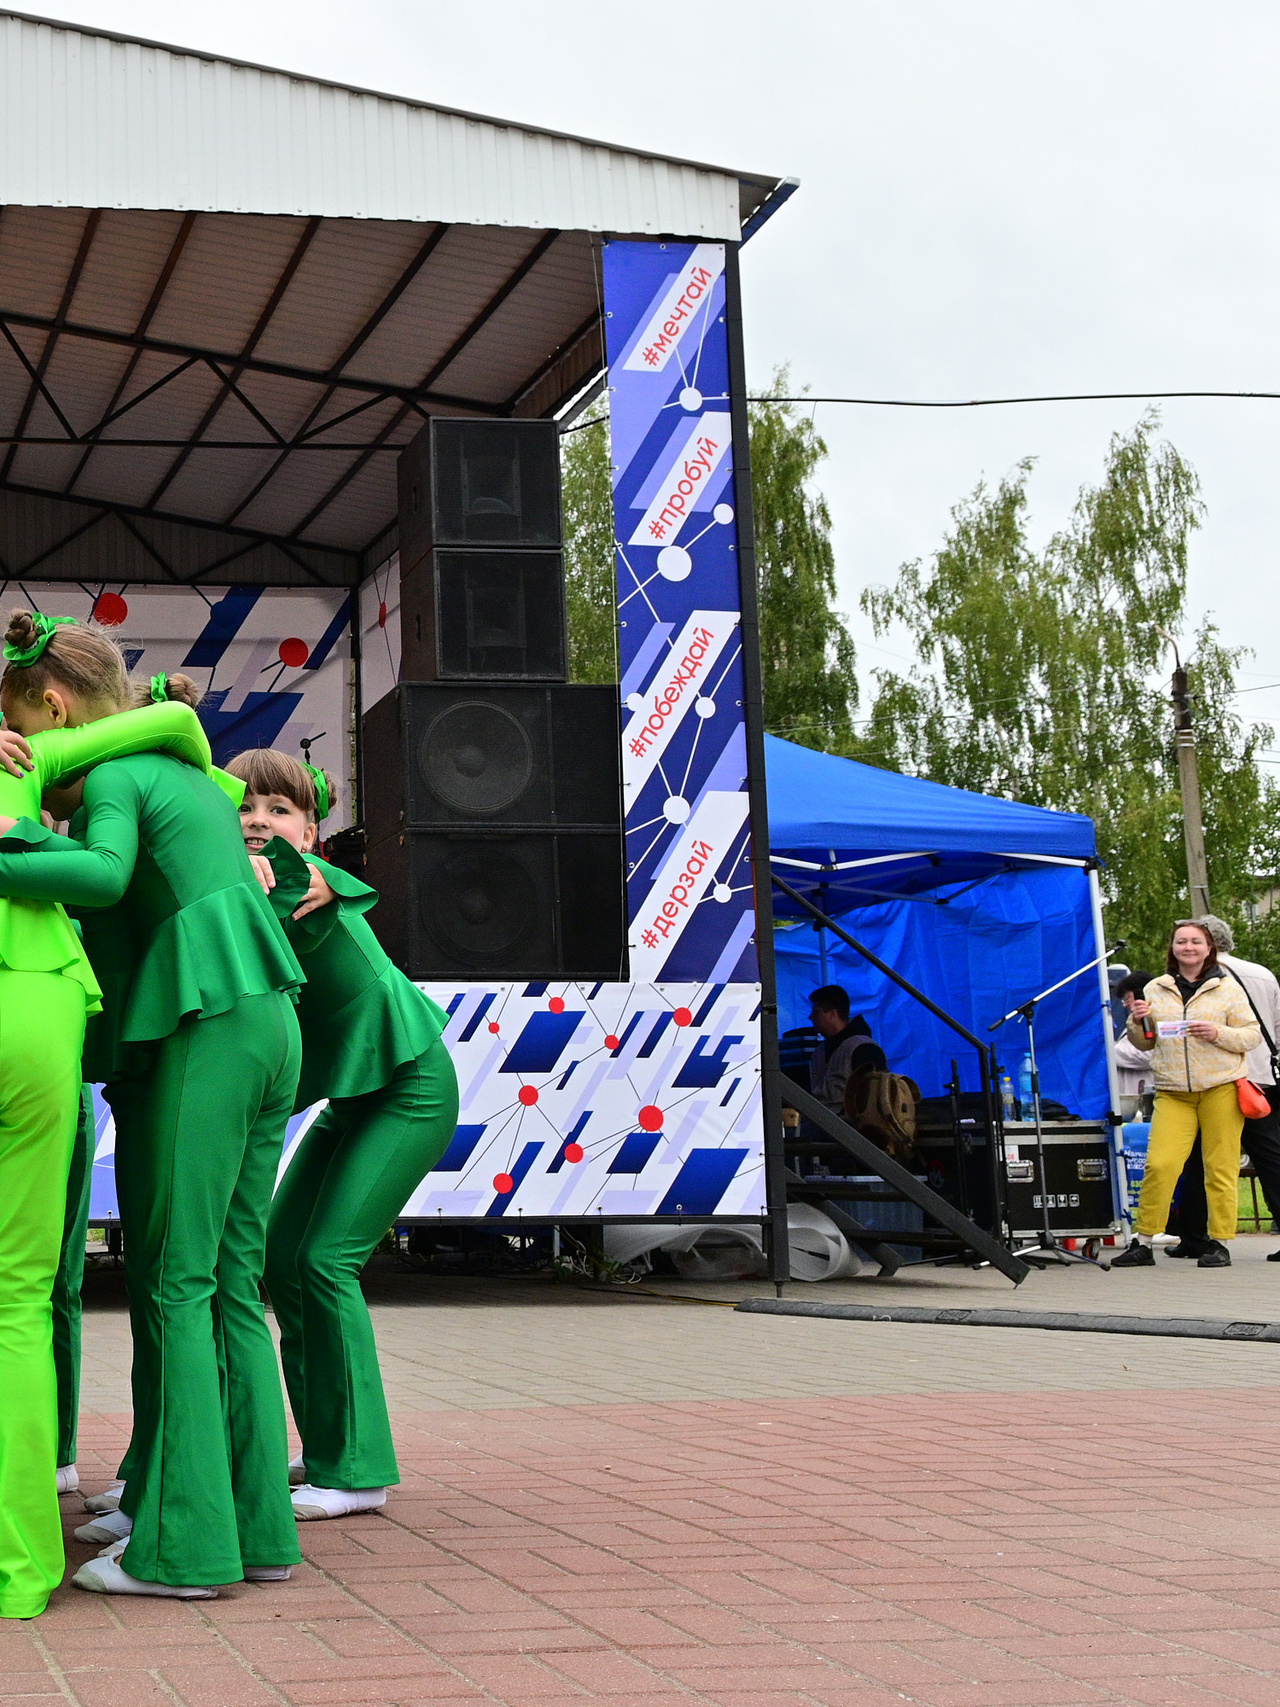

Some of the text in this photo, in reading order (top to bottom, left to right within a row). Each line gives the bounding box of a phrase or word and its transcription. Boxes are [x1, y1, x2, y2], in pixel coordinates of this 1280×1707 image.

[643, 267, 712, 366] #мечтай
[649, 437, 718, 540] #пробуй
[630, 627, 714, 758] #побеждай
[642, 840, 714, 949] #дерзай
